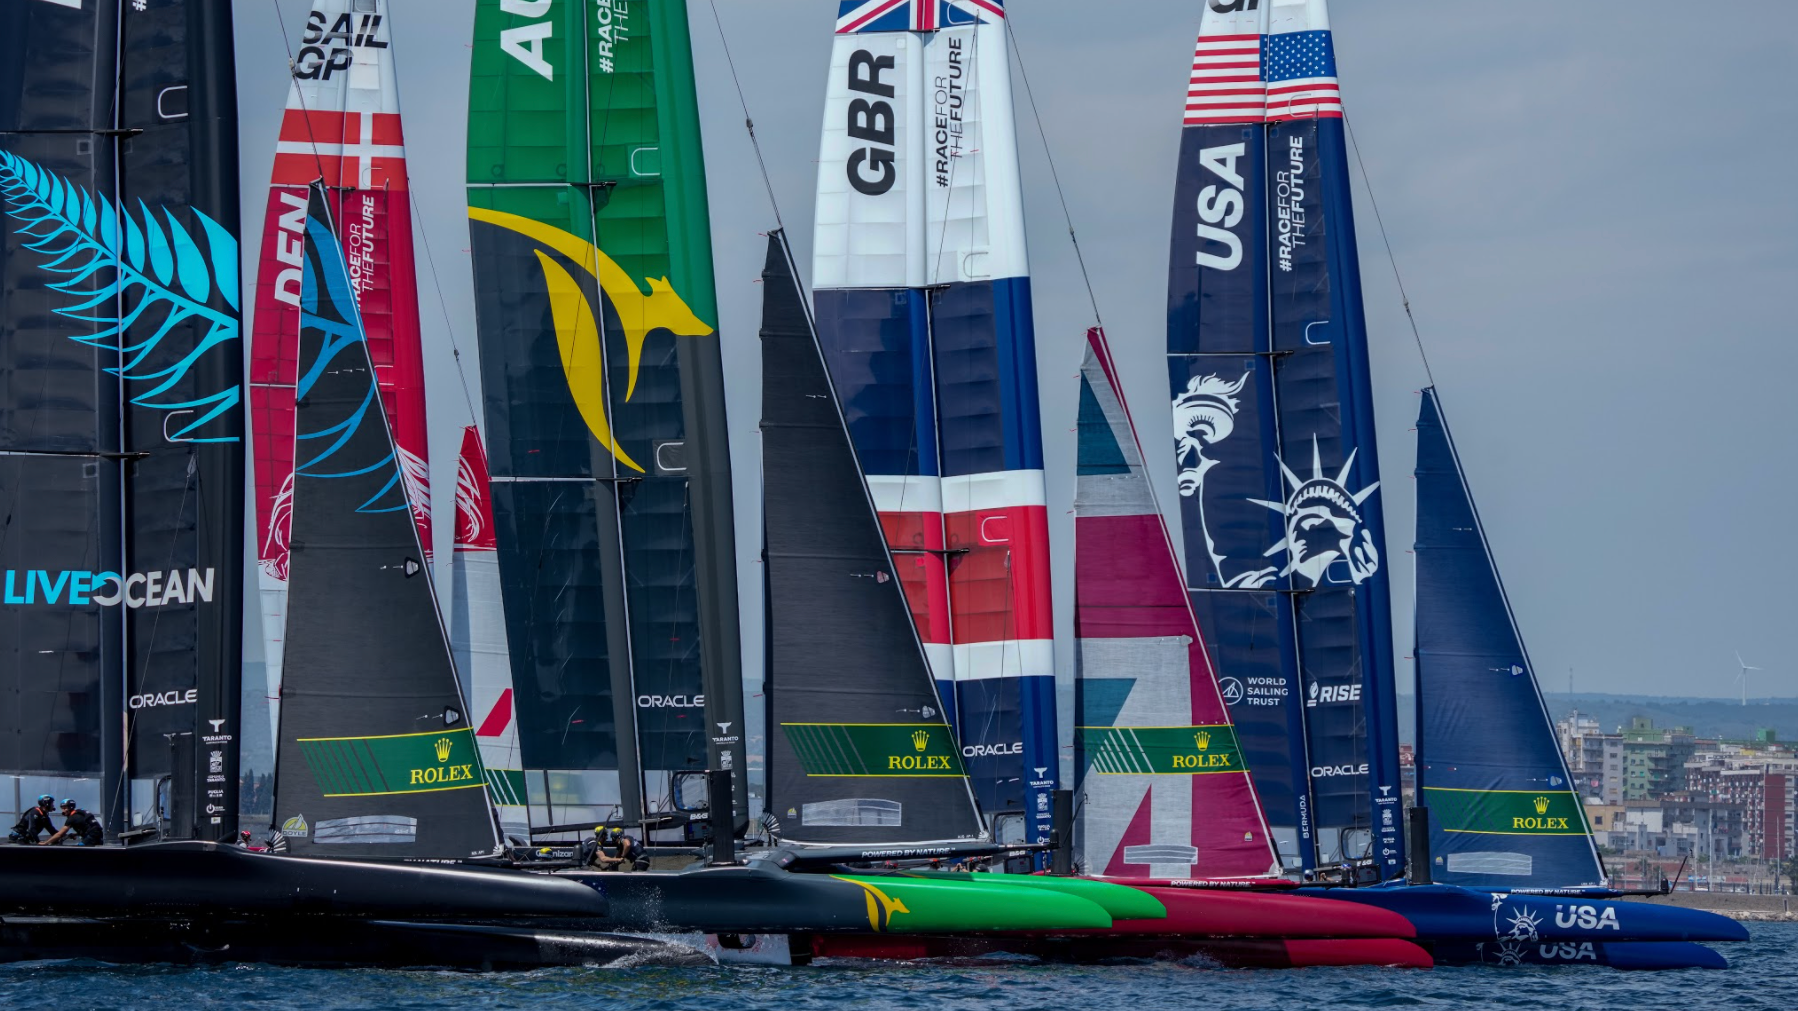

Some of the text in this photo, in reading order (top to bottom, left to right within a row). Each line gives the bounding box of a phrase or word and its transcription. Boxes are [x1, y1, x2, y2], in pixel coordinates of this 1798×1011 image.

[303, 10, 389, 49] SAIL
[295, 46, 354, 81] GP
[948, 37, 963, 162] THEFUTURE
[847, 49, 896, 196] GBR
[935, 75, 949, 188] #RACEFOR
[1289, 135, 1306, 249] THEFUTURE
[1195, 142, 1245, 271] USA
[1277, 170, 1293, 272] #RACEFOR
[1247, 677, 1286, 686] WORLD
[129, 689, 198, 709] ORACLE
[1247, 687, 1288, 696] SAILING
[1319, 684, 1362, 703] RISE
[638, 695, 705, 708] ORACLE
[1247, 698, 1280, 706] TRUST
[962, 742, 1023, 758] ORACLE
[888, 756, 951, 769] ROLEX
[1172, 754, 1231, 768] ROLEX
[1311, 764, 1369, 777] ORACLE
[410, 764, 473, 784] ROLEX
[1299, 794, 1310, 838] BERMUDA
[1512, 817, 1569, 830] ROLEX
[862, 850, 902, 858] POWERED
[904, 849, 914, 857] BY
[1555, 904, 1620, 930] USA
[1539, 942, 1597, 960] USA
